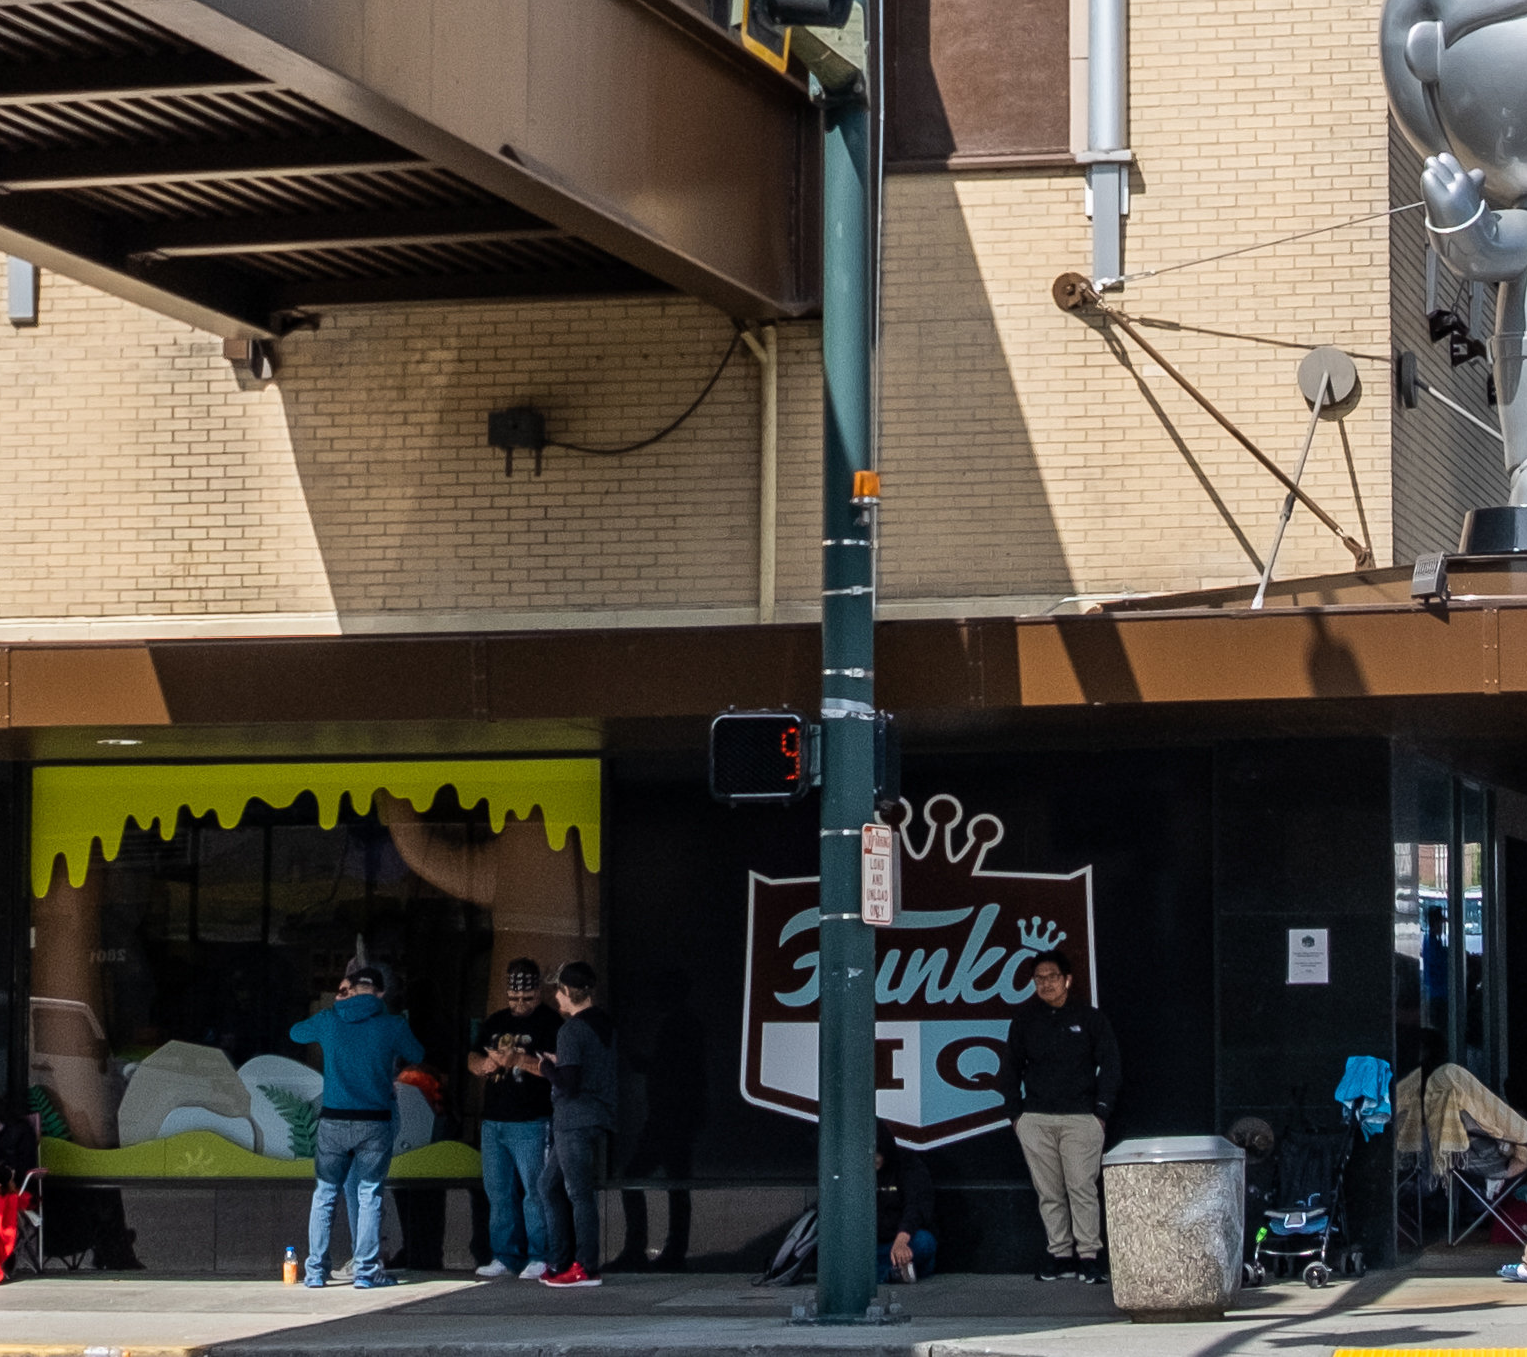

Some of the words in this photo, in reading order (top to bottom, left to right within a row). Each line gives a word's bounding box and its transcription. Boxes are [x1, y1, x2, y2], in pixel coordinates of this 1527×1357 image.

[870, 858, 885, 871] LOAD
[872, 874, 884, 885] AND
[867, 889, 888, 902] UNLOAD
[869, 905, 884, 917] ONLY
